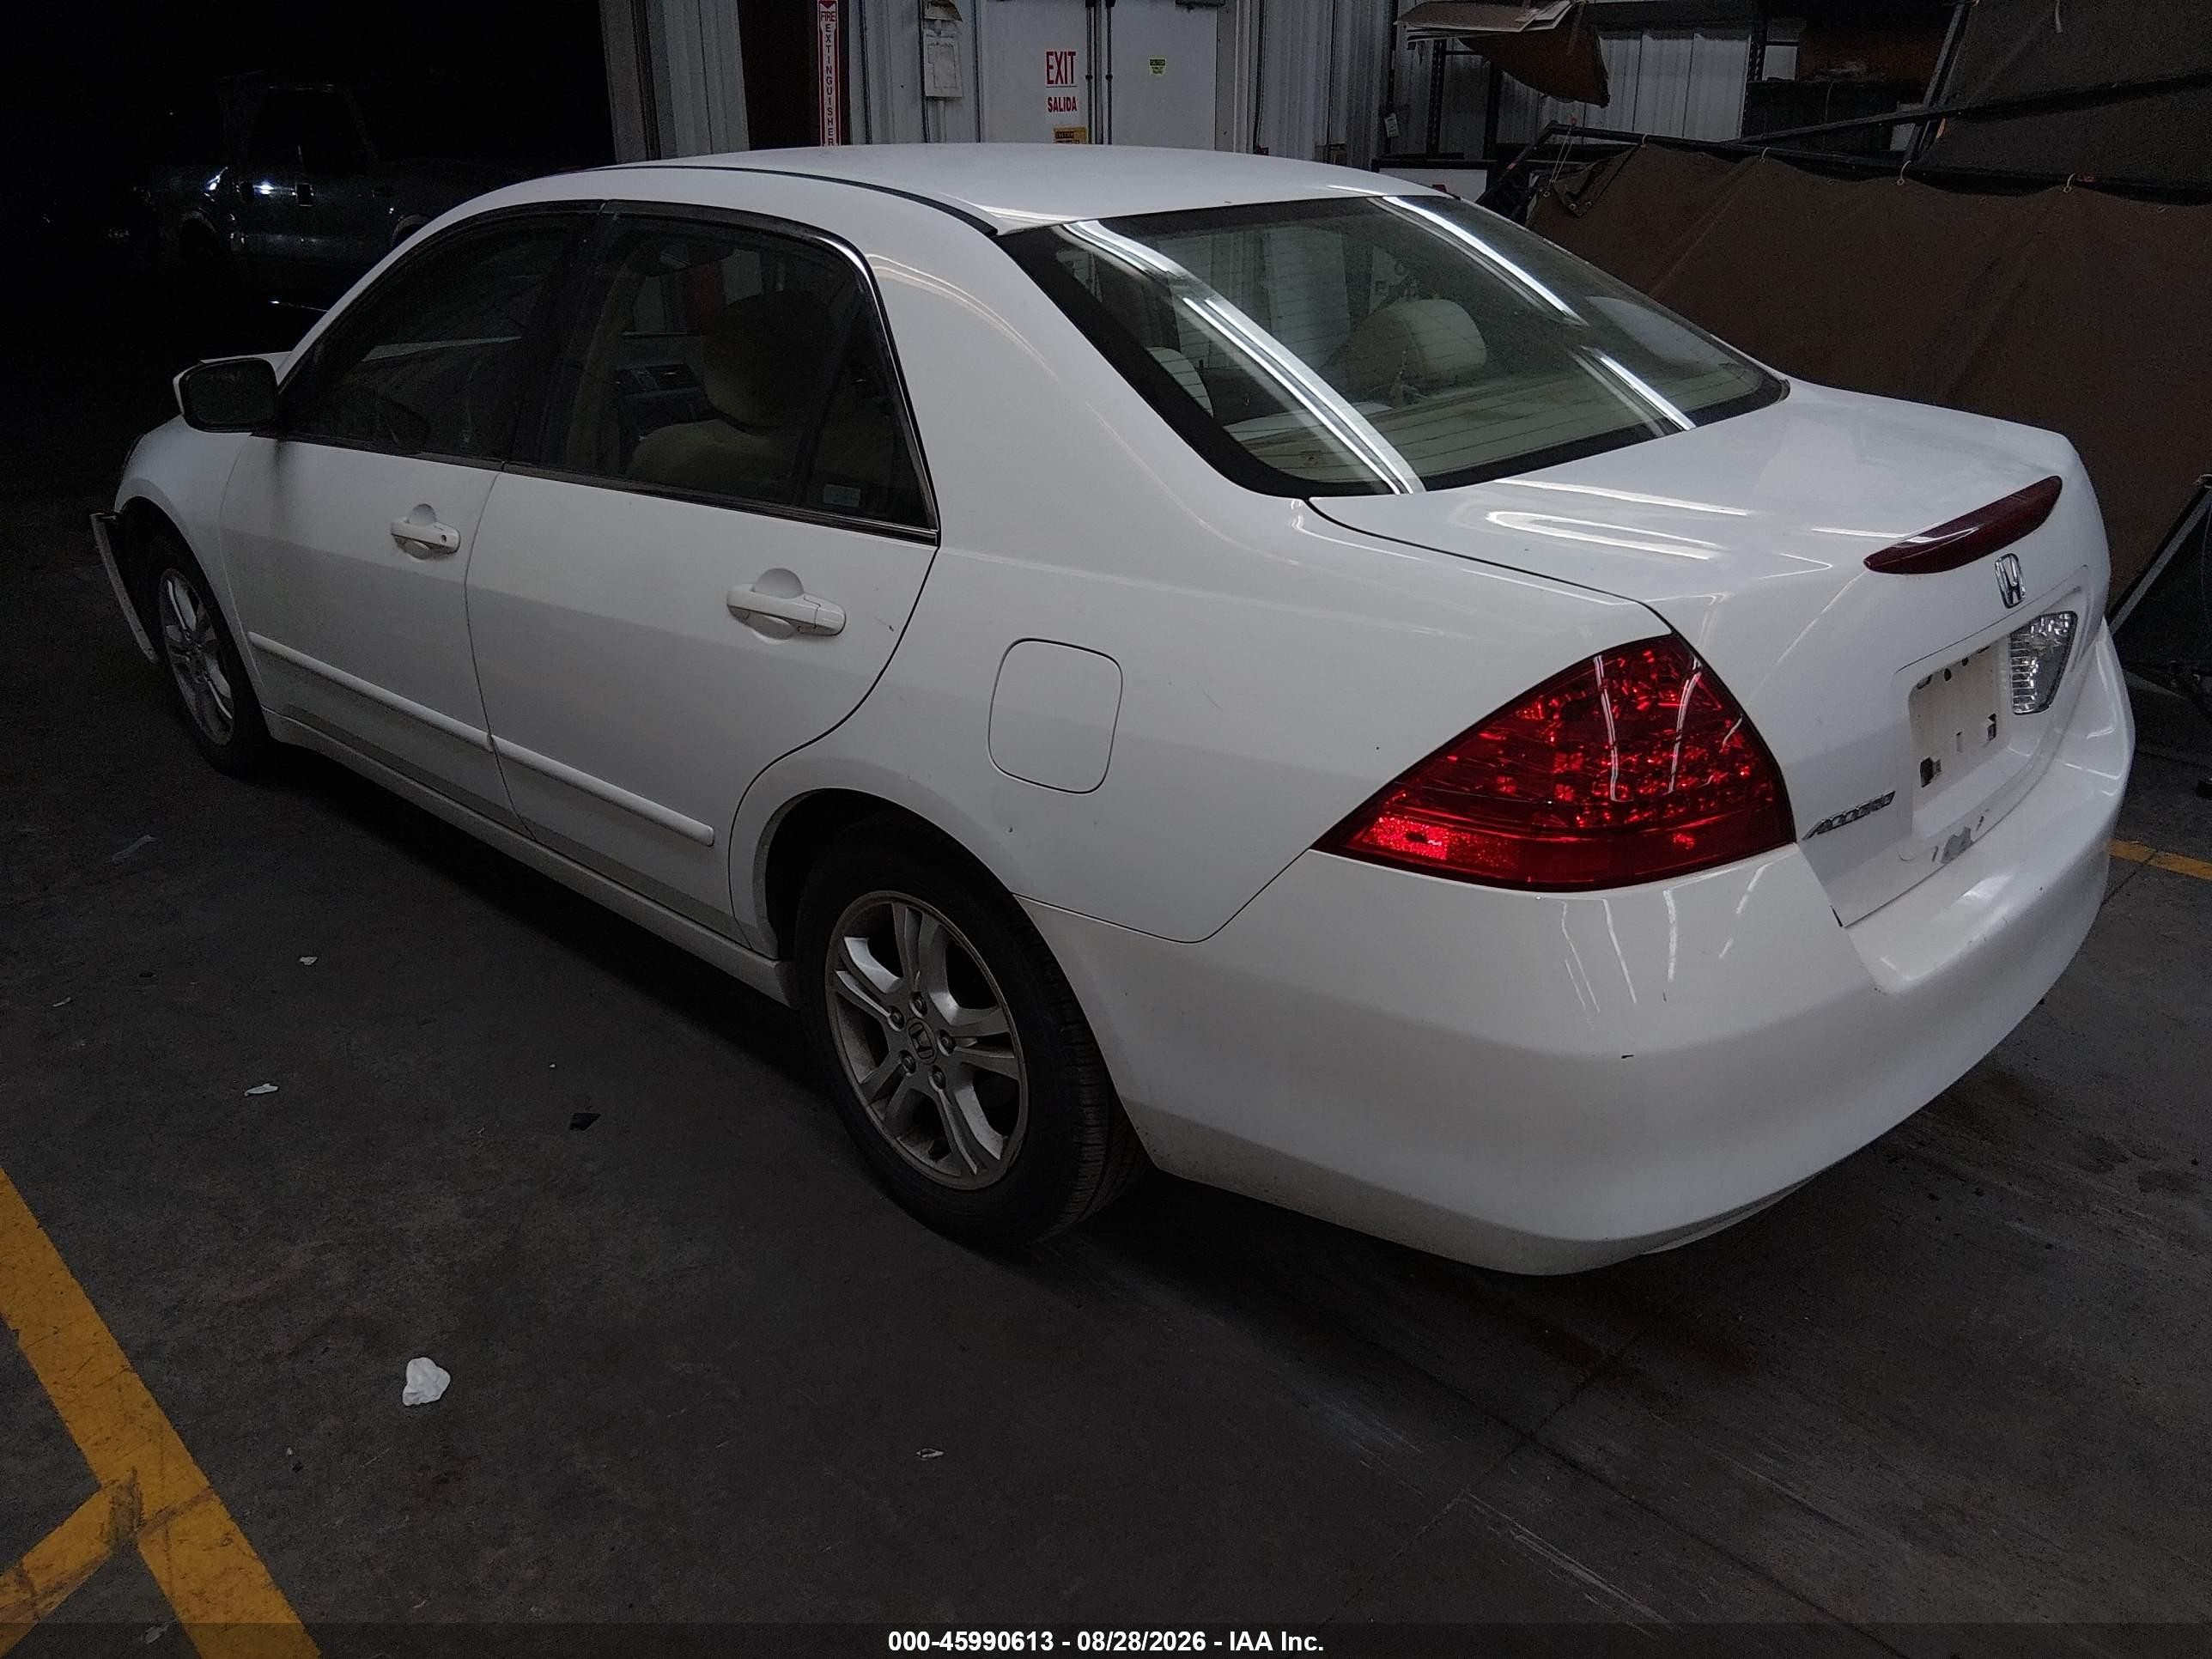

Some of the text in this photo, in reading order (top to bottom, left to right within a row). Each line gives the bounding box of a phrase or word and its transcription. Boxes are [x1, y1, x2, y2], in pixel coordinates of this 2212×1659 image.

[821, 11, 836, 21] FIRE
[1046, 51, 1076, 84] EXIT
[824, 24, 835, 146] EXTINGUISHER
[1047, 96, 1077, 112] SALIDA
[1802, 791, 1896, 841] ACCORD
